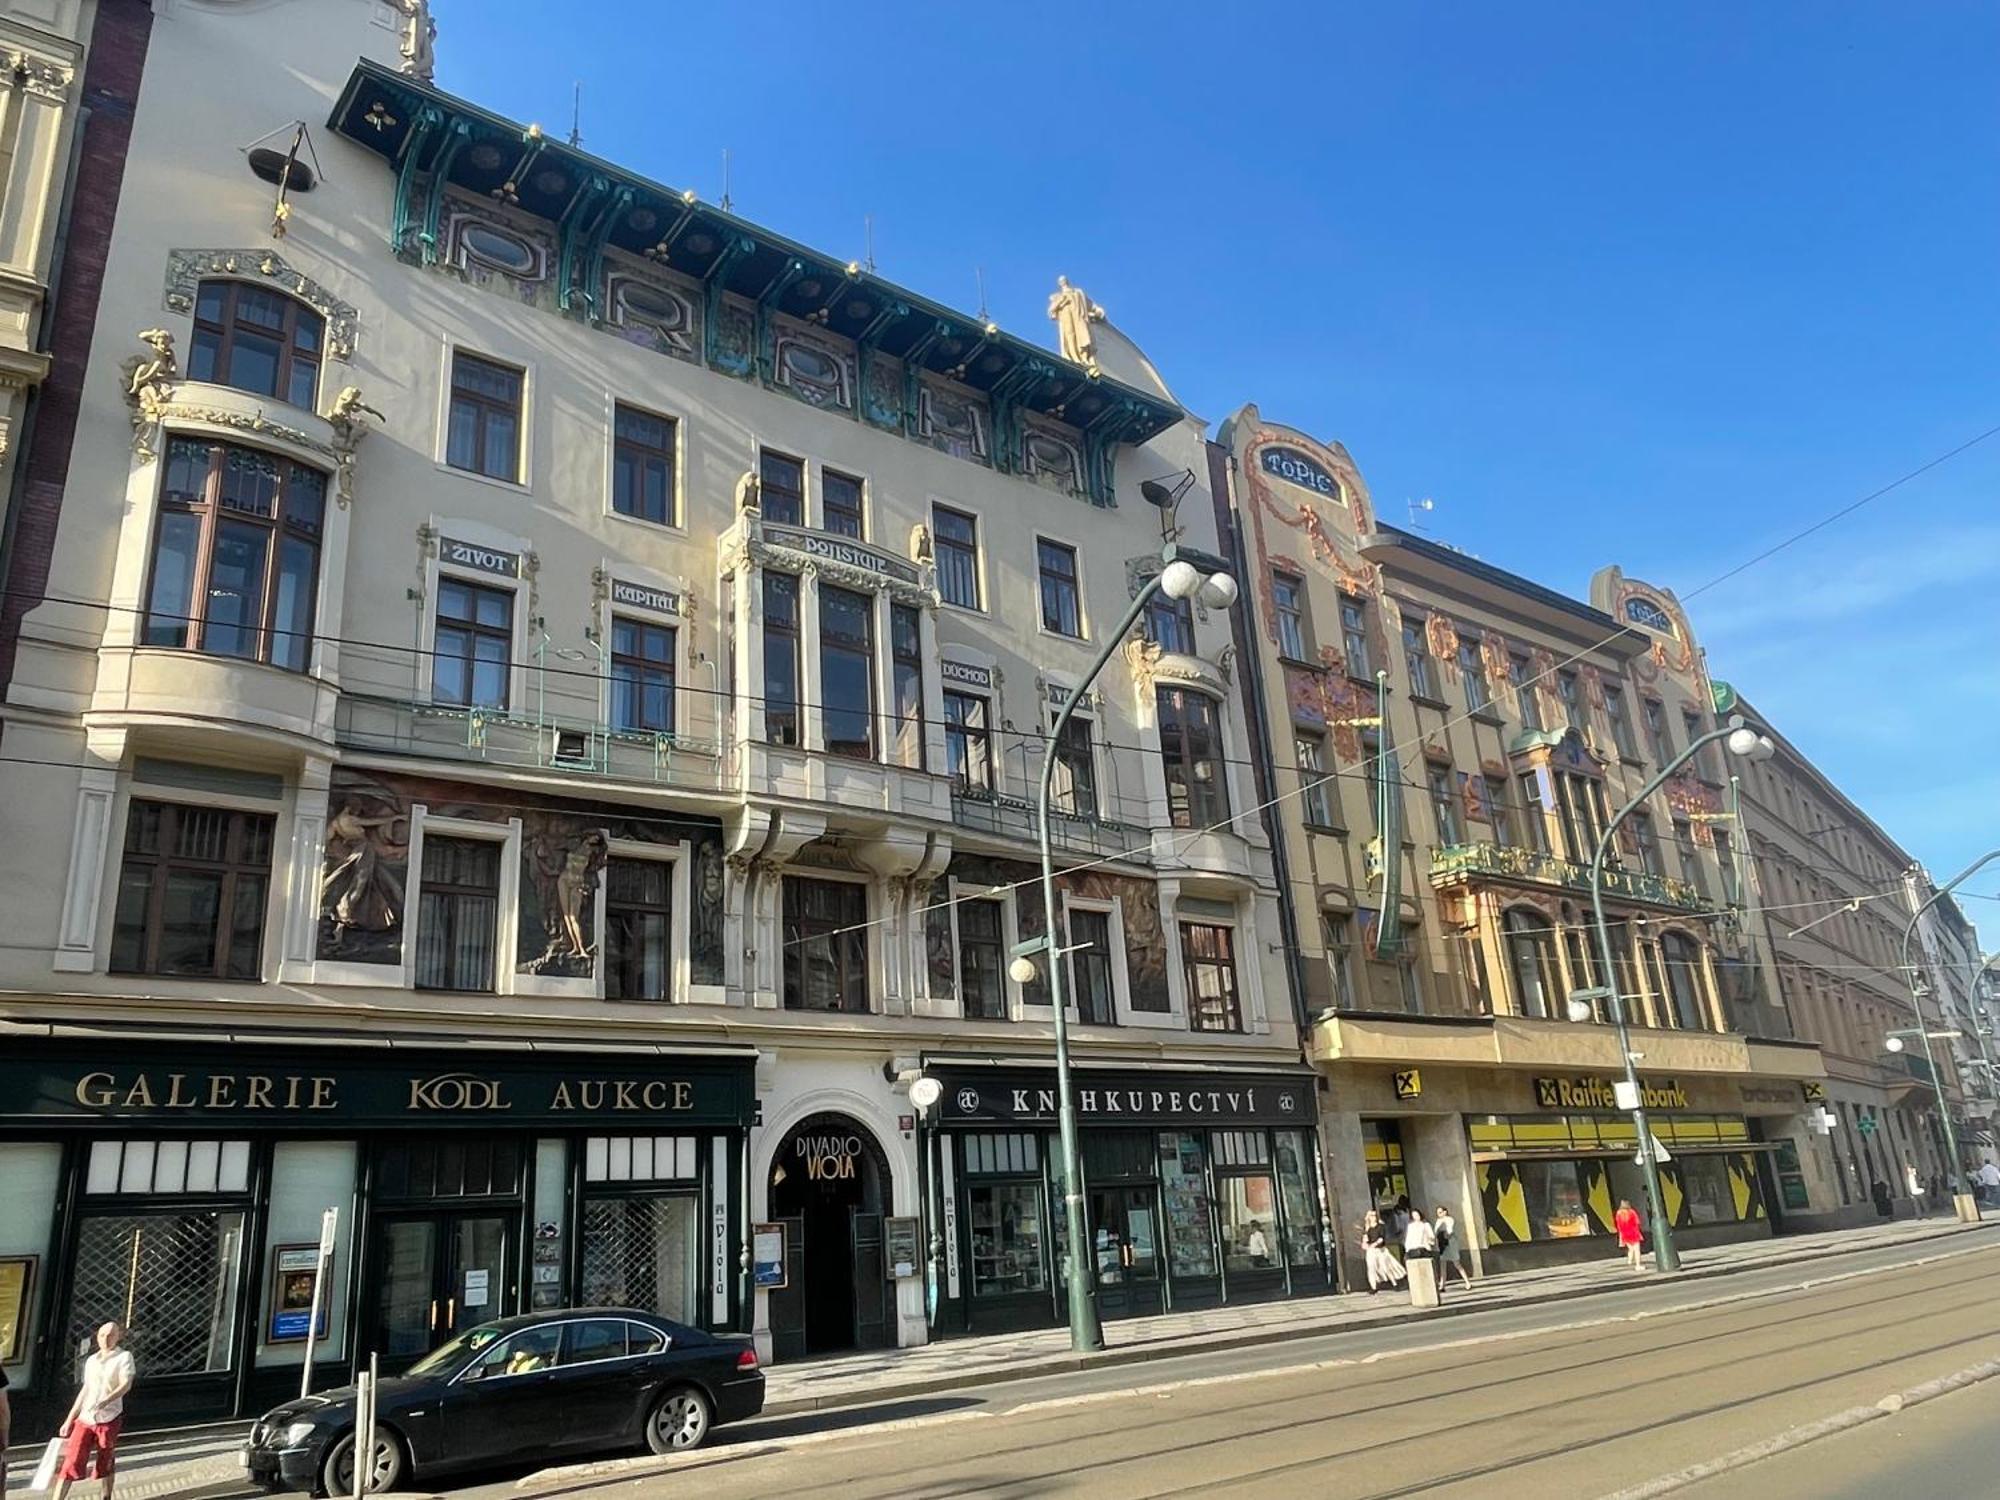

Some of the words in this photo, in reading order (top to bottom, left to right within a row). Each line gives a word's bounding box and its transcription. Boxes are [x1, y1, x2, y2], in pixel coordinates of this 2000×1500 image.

[75, 1072, 339, 1109] GALERIE
[406, 1072, 512, 1109] KODL
[549, 1080, 694, 1109] AUKCE
[1012, 1088, 1256, 1113] KNHKUPECTVÍ
[1558, 1077, 1688, 1108] Raiffenbank
[796, 1136, 861, 1157] DIVADLO
[806, 1153, 856, 1180] VIOLA
